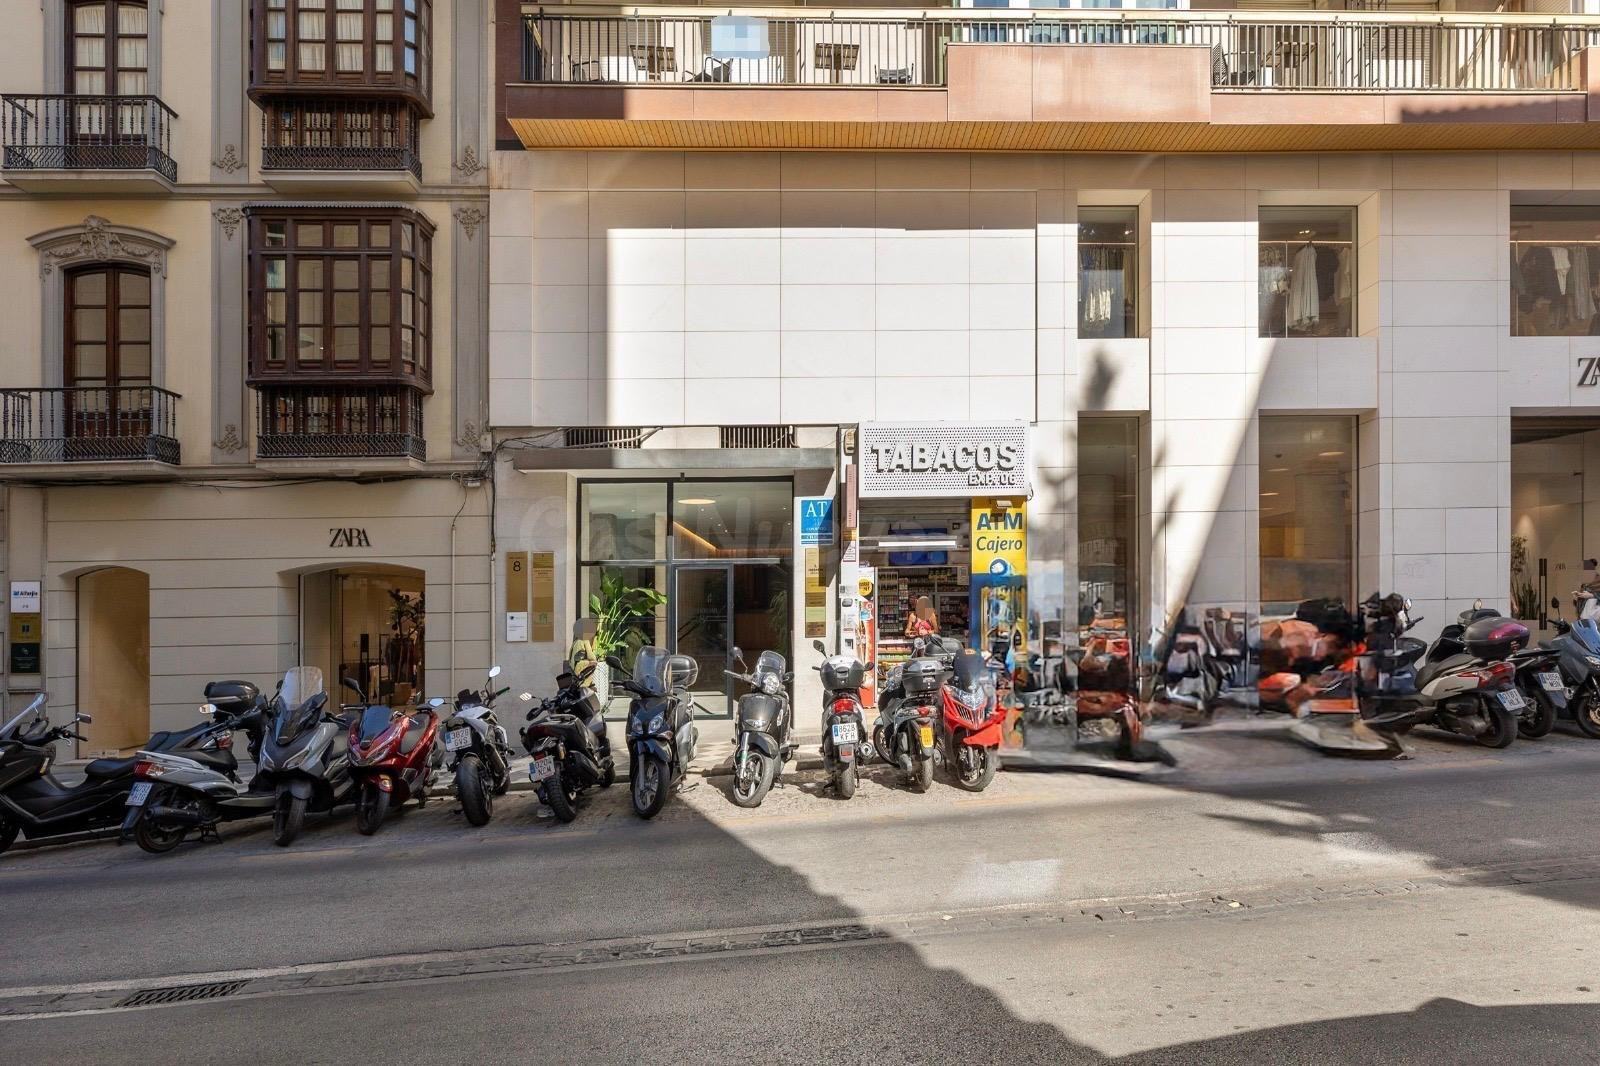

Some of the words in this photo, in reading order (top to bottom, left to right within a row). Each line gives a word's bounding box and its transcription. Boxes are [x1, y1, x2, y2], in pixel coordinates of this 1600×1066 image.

[870, 442, 1017, 473] TABACOS
[999, 474, 1017, 486] 06
[805, 500, 828, 517] AT
[976, 512, 1023, 530] ATM
[329, 527, 371, 547] ZARA
[976, 536, 1023, 554] Cajero
[512, 560, 521, 572] 8
